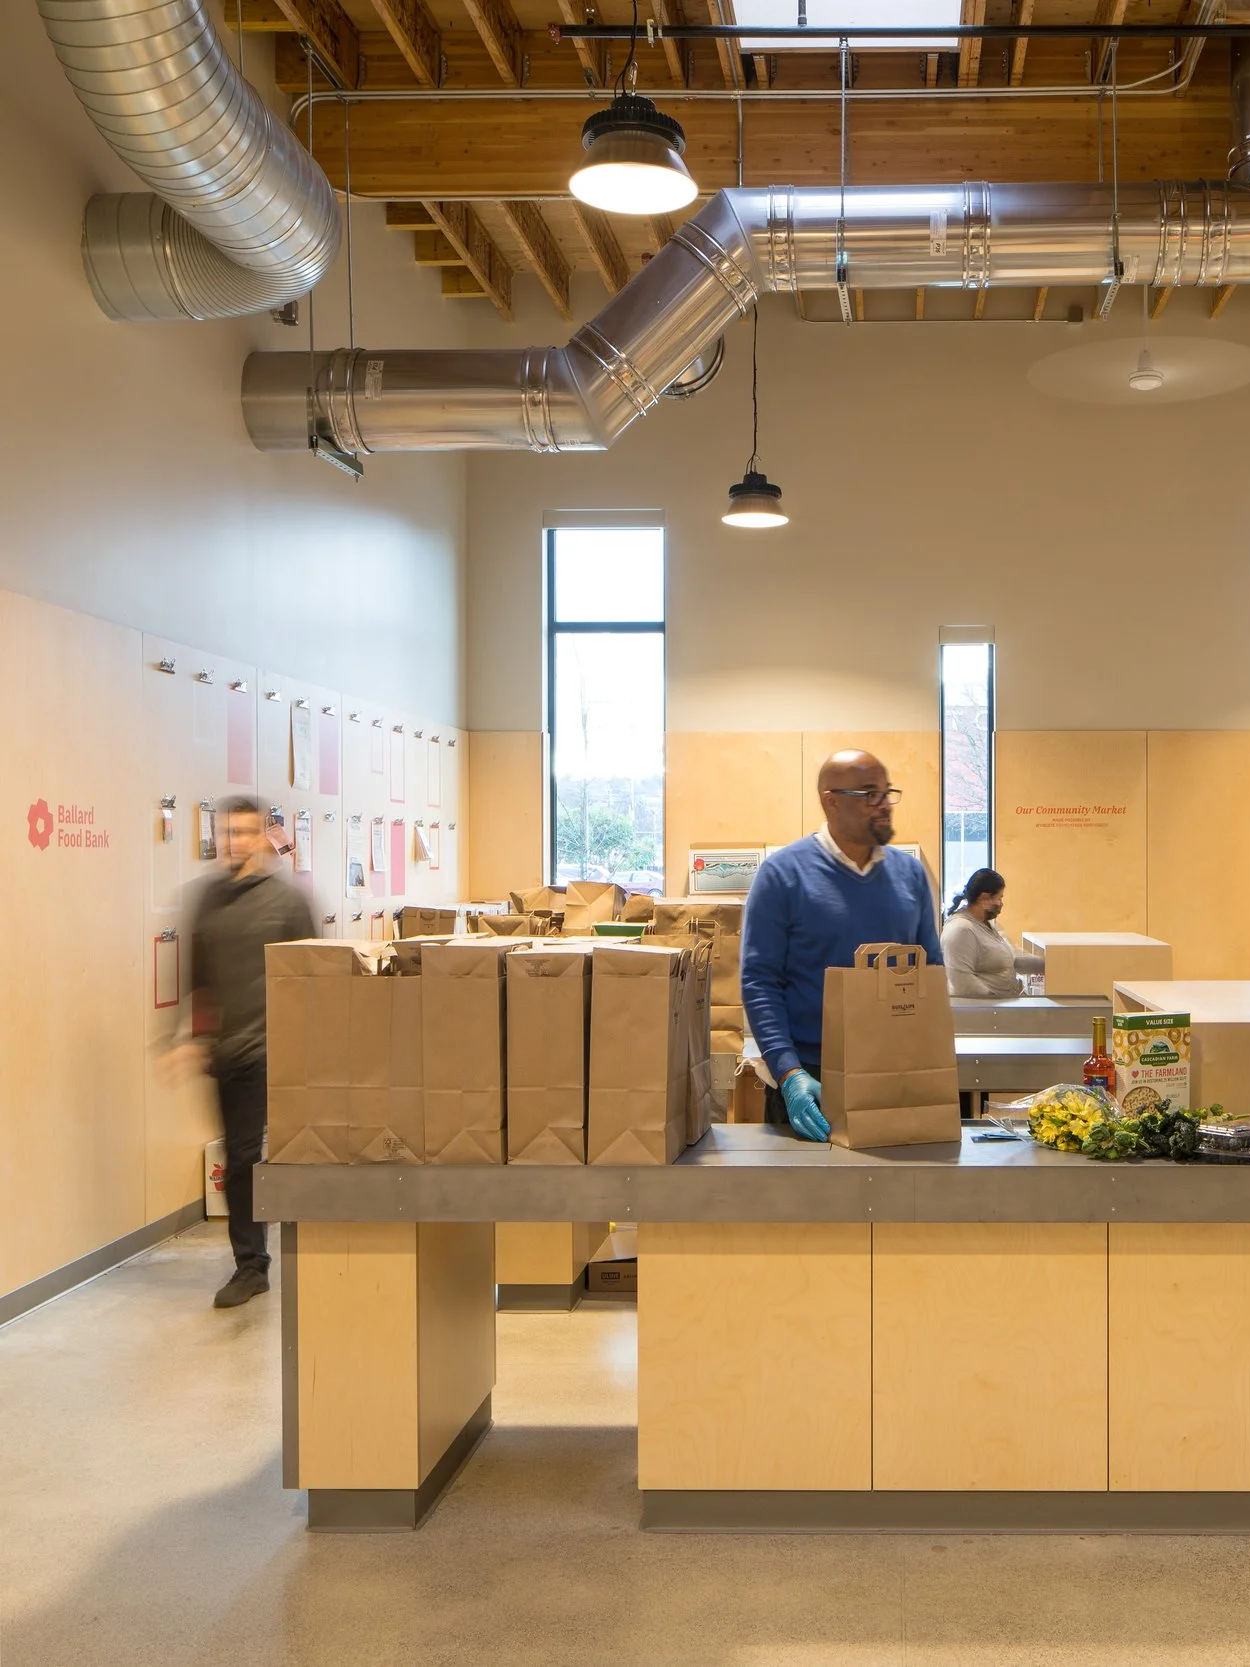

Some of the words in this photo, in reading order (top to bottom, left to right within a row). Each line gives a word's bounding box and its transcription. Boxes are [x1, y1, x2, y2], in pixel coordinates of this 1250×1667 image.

[58, 804, 94, 825] Ballard
[1015, 806, 1034, 815] Our
[1036, 805, 1090, 816] Community
[1092, 805, 1127, 815] Market
[58, 828, 82, 848] Food
[85, 829, 110, 848] Bank
[1141, 1069, 1153, 1079] THE
[1155, 1066, 1188, 1078] FARMLAND
